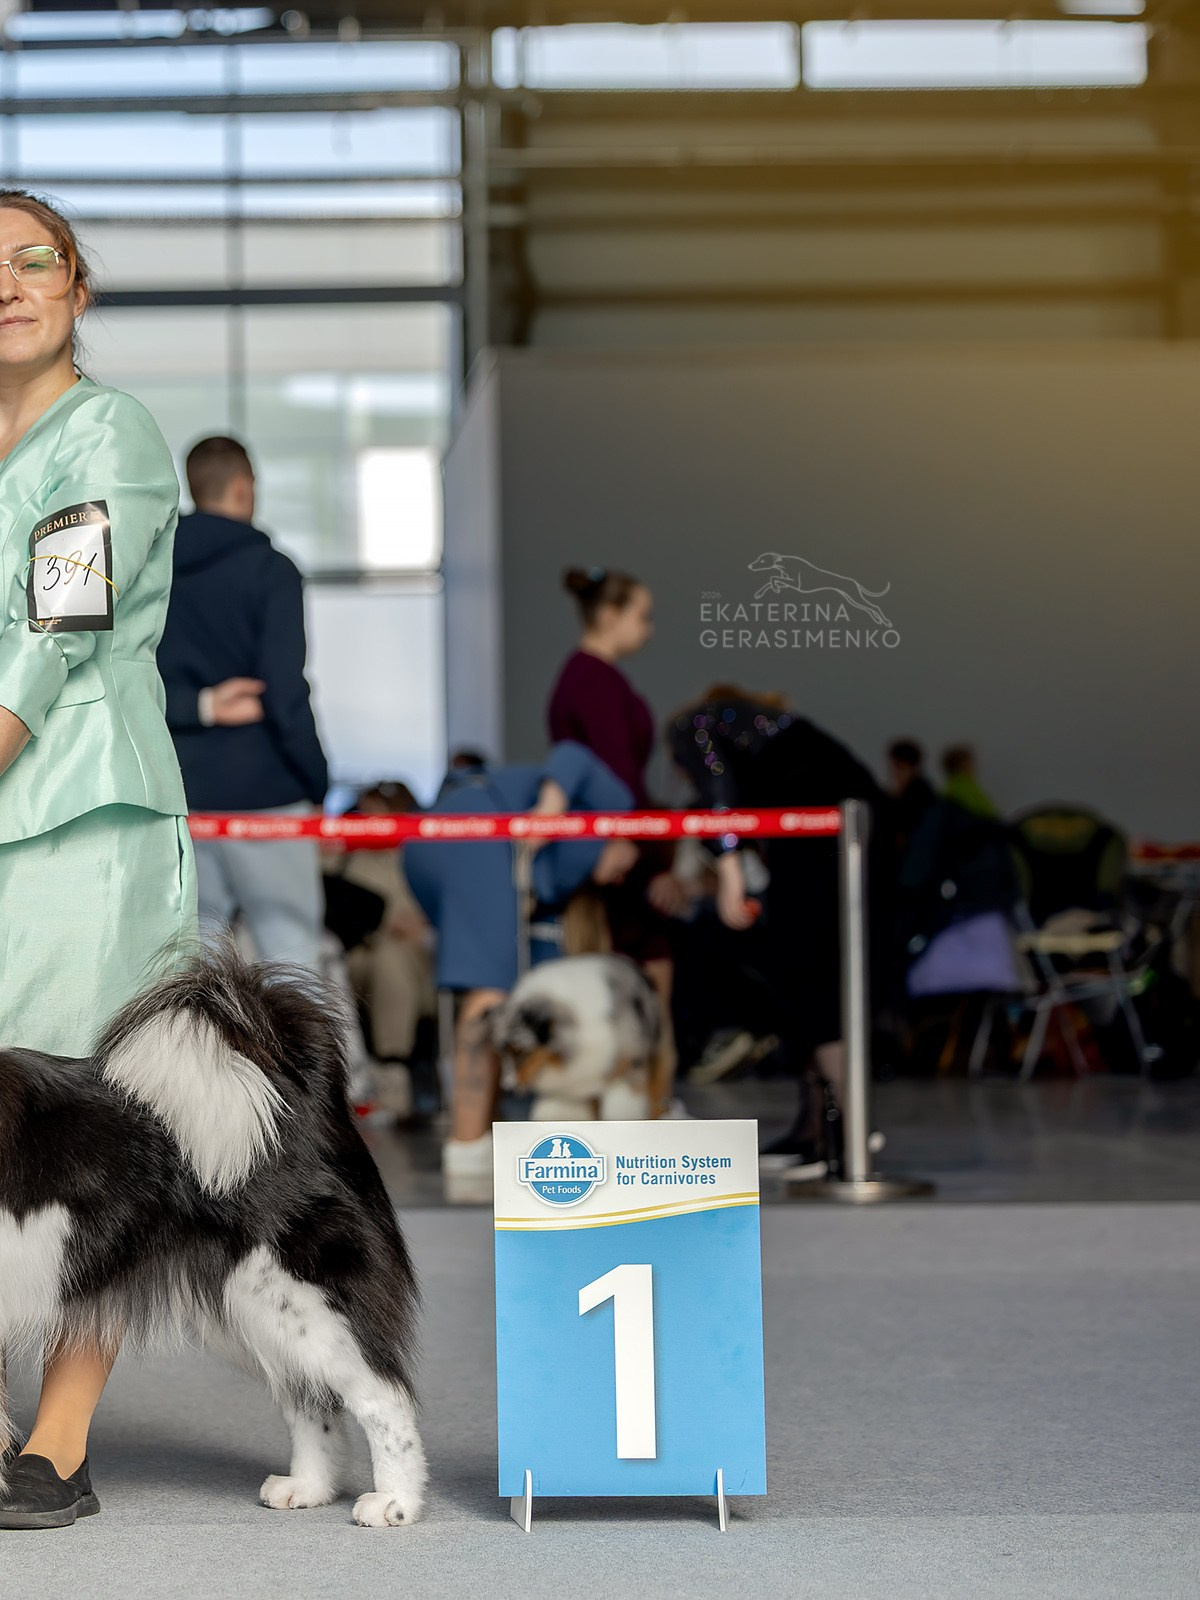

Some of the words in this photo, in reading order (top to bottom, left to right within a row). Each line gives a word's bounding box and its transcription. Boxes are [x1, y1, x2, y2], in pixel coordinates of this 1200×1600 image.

[34, 511, 88, 541] PREMIER
[43, 550, 98, 591] 391
[525, 1161, 598, 1179] Farmina
[615, 1155, 676, 1169] Nutrition
[681, 1155, 732, 1171] System
[616, 1172, 636, 1185] for
[641, 1171, 716, 1185] Carnivores
[542, 1185, 556, 1194] Pet
[557, 1185, 582, 1194] Foods
[578, 1263, 657, 1459] 1
